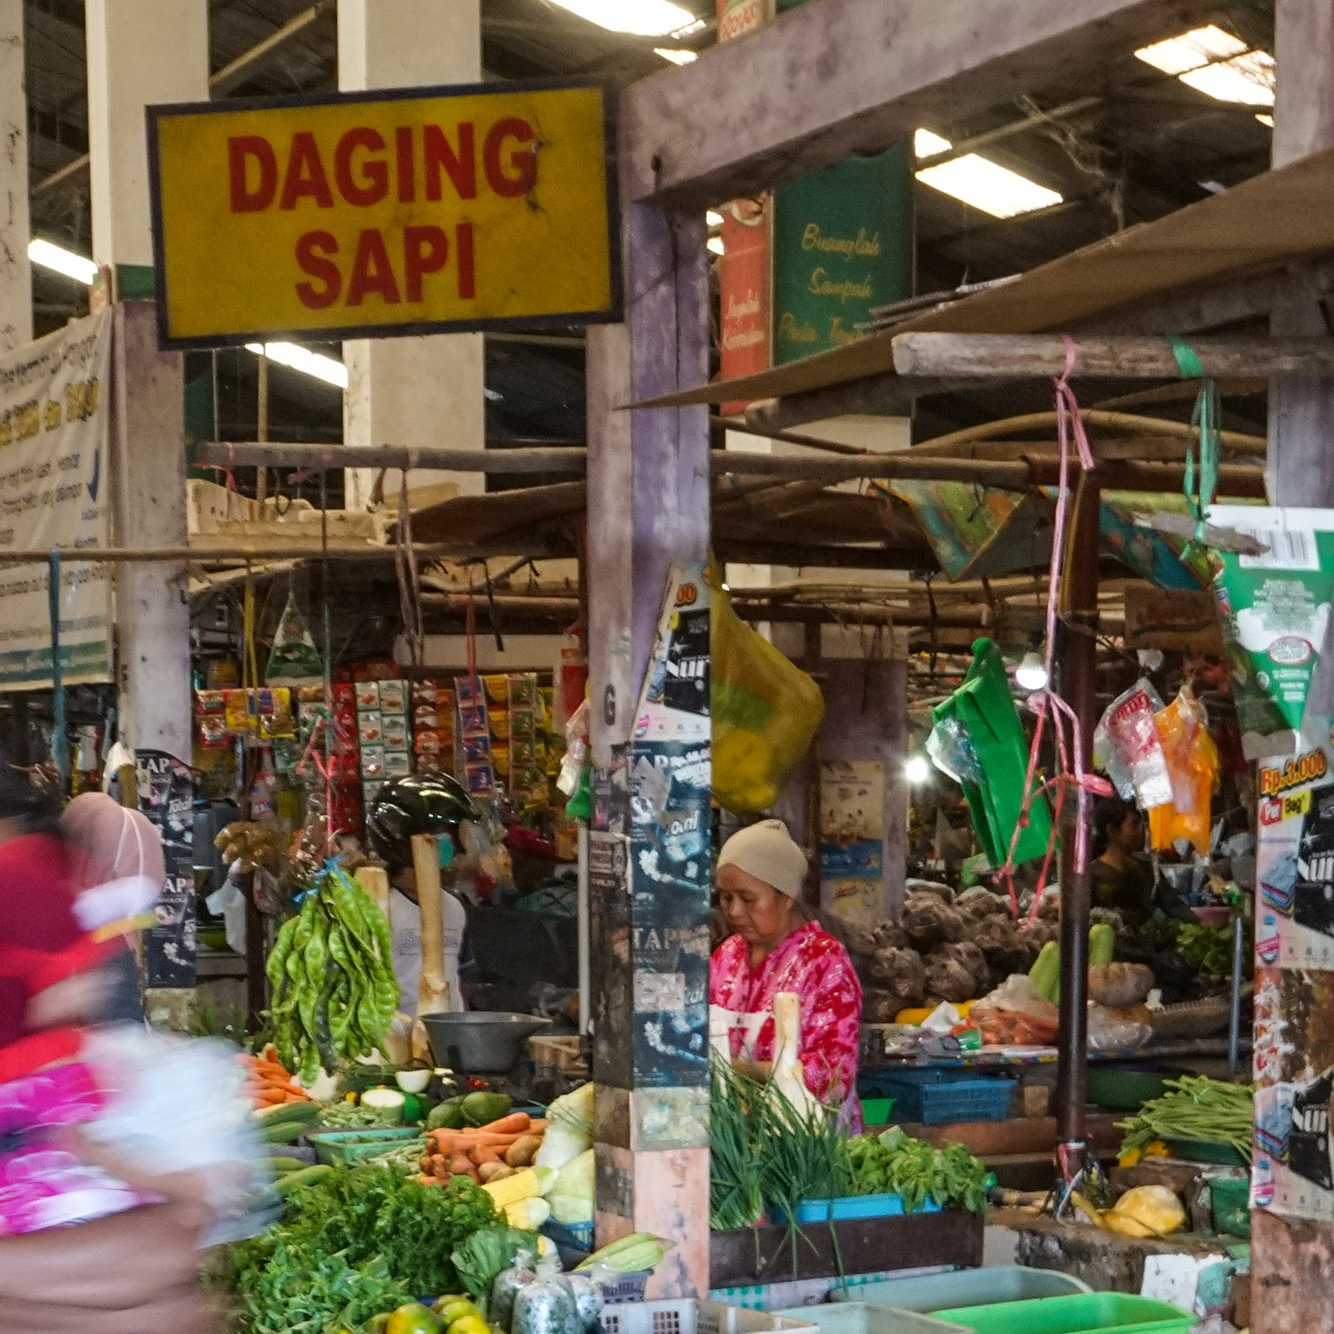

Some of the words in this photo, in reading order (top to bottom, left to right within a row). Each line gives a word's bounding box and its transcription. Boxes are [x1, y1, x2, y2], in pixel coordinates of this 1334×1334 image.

[227, 117, 539, 214] DAGING
[801, 222, 880, 262] Buanglah
[293, 222, 477, 310] SAPI
[808, 266, 872, 305] Sampah
[162, 875, 187, 894] AP
